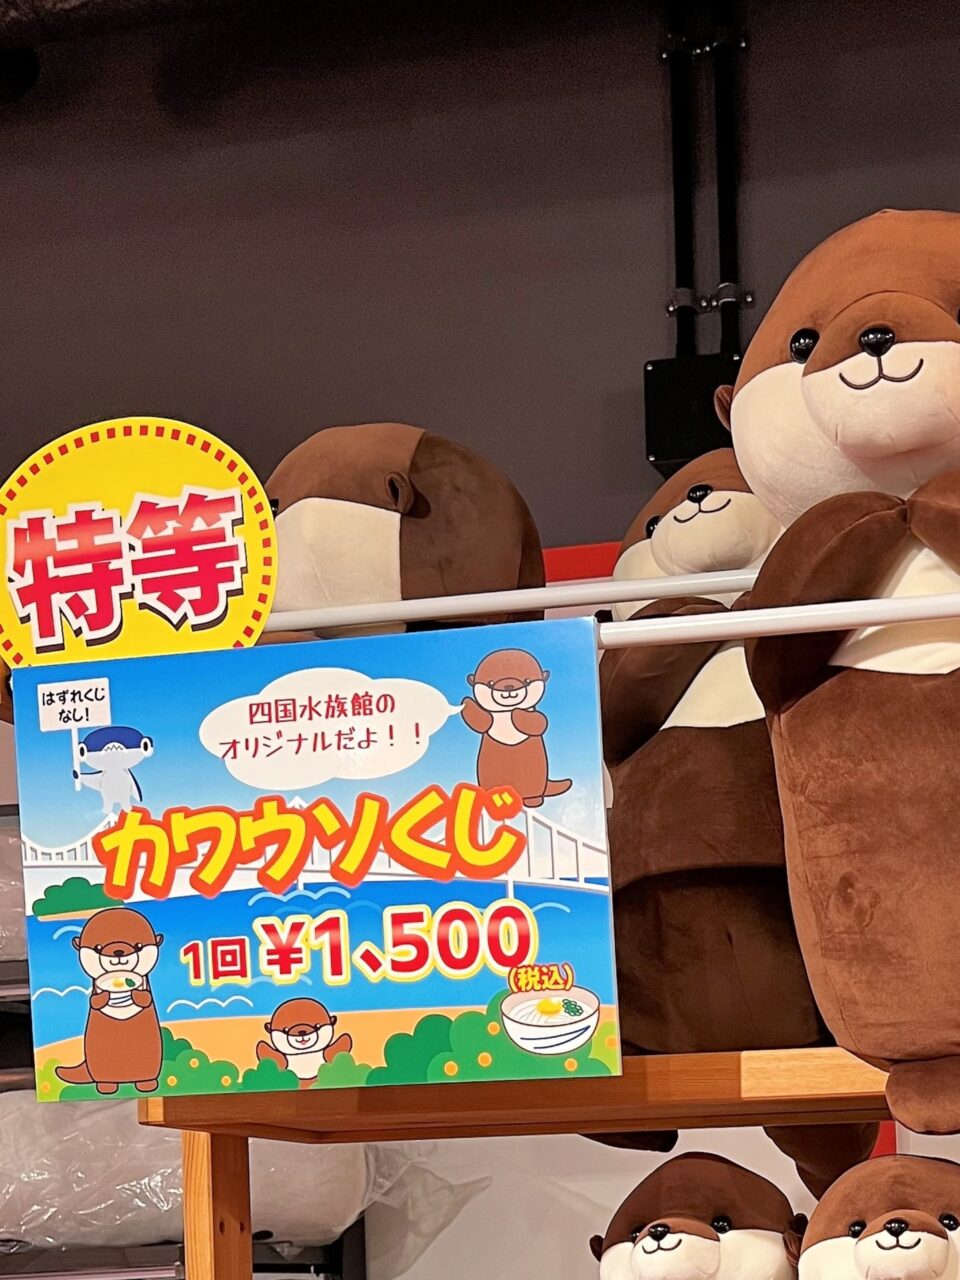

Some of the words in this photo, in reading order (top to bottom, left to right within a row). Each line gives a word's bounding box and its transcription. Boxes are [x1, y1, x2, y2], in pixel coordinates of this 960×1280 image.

[9, 488, 244, 647] 特等
[41, 687, 106, 707] はずれくじ
[248, 692, 396, 725] 四国水族館の
[218, 722, 421, 760] オリジナルだよ！！
[95, 785, 524, 897] カワウソくじ
[181, 937, 249, 982] 1回
